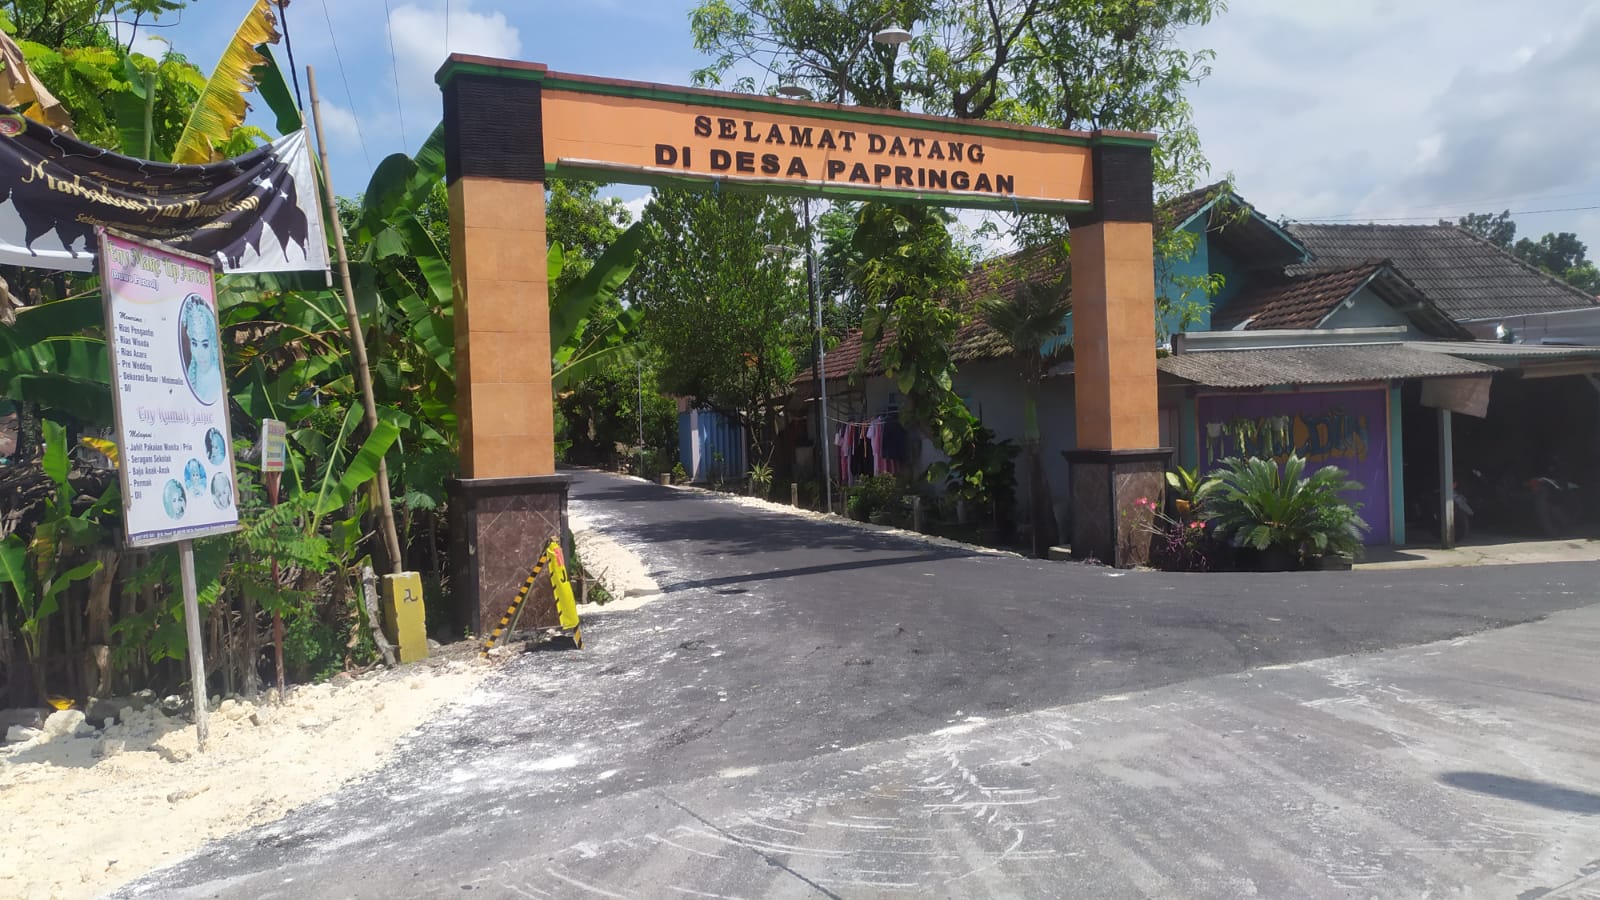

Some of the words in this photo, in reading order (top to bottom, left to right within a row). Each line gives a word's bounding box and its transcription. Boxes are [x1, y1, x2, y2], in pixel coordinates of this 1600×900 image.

[694, 115, 856, 152] SELAMAT
[868, 133, 986, 164] DATANG
[655, 143, 691, 168] DI
[710, 148, 808, 178] DESA
[827, 159, 1014, 193] PAPRINGAN
[144, 196, 183, 222] Yaa
[162, 257, 179, 283] Up
[119, 323, 130, 334] Rias
[120, 336, 131, 346] Rias
[121, 347, 132, 357] Rias
[133, 348, 147, 358] Acara
[122, 359, 131, 368] Pre
[133, 360, 152, 372] Wedding
[123, 371, 144, 382] Dekorasi
[137, 406, 157, 426] Eny
[144, 443, 162, 451] Pakaian
[131, 456, 153, 466] Seragam
